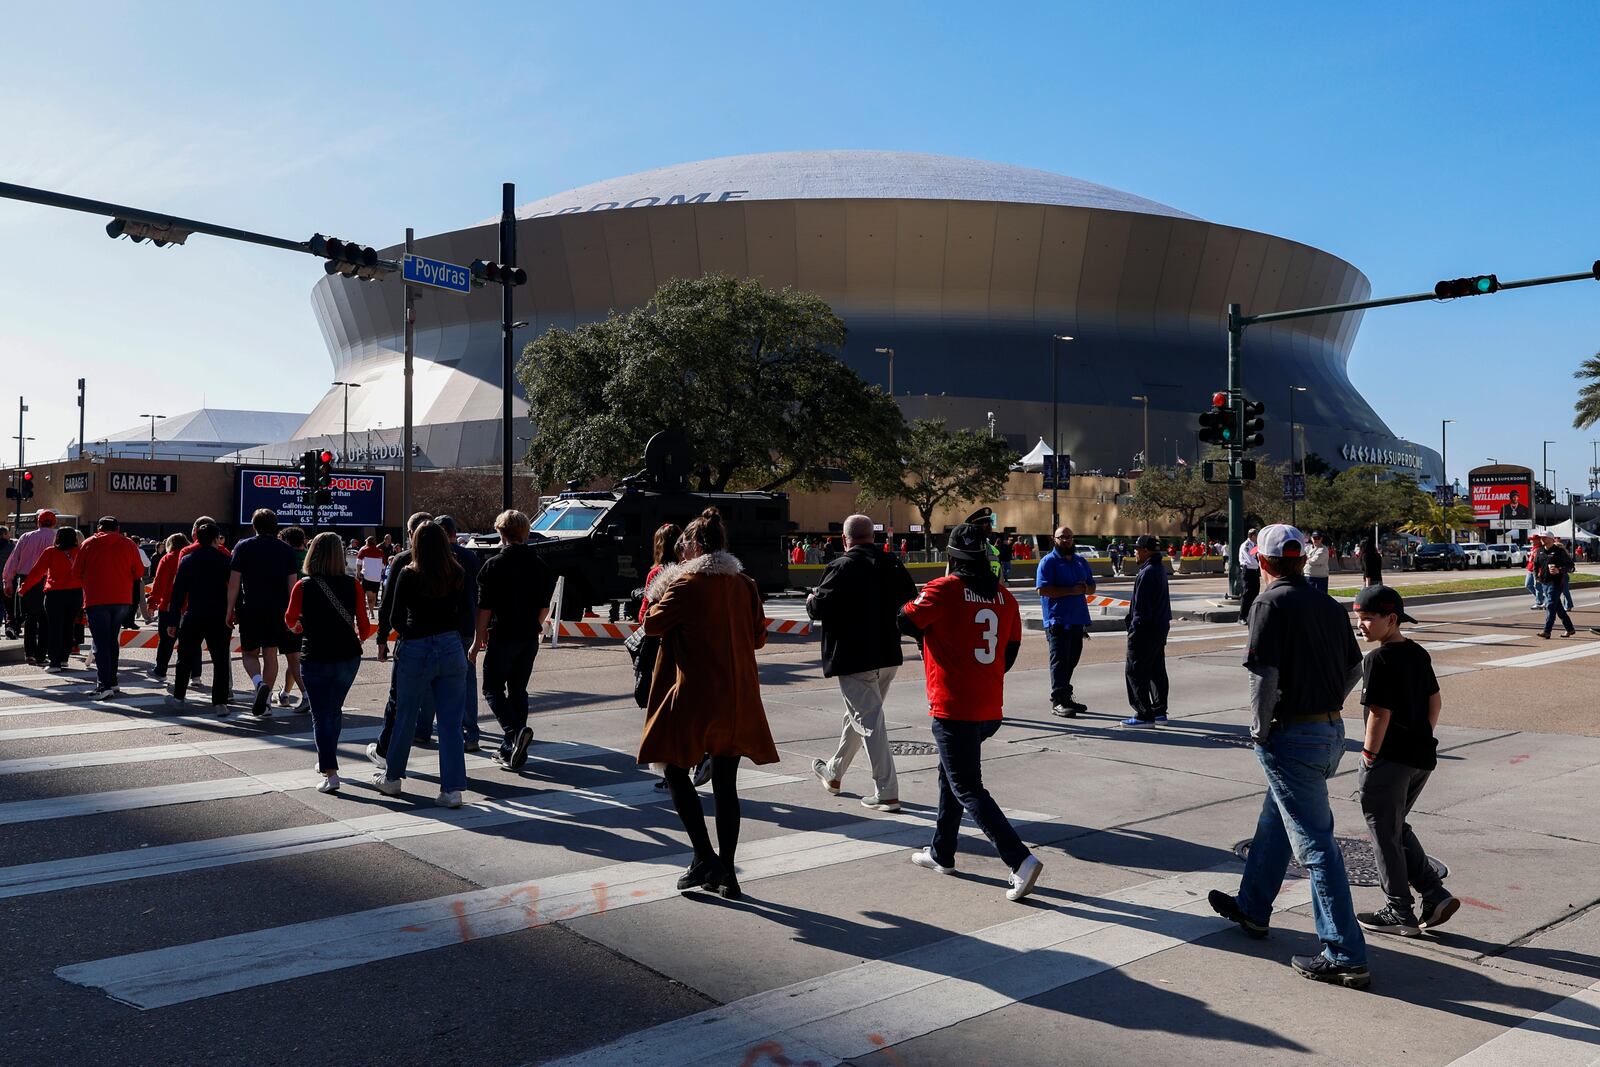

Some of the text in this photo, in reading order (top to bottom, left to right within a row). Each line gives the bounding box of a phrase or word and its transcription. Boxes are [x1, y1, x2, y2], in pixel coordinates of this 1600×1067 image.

[415, 258, 466, 286] Poydras
[1342, 443, 1387, 465] CAESARS
[65, 477, 84, 490] GARAGE
[112, 474, 171, 492] GARAGE 1
[254, 474, 298, 489] CLEAR
[327, 477, 374, 491] POLICY
[280, 488, 295, 496] Clear
[336, 489, 351, 497] than
[1473, 486, 1492, 494] KATT
[1473, 493, 1511, 501] WILLIAMS
[334, 503, 348, 511] Bags
[322, 510, 339, 518] larger
[974, 608, 999, 665] 3
